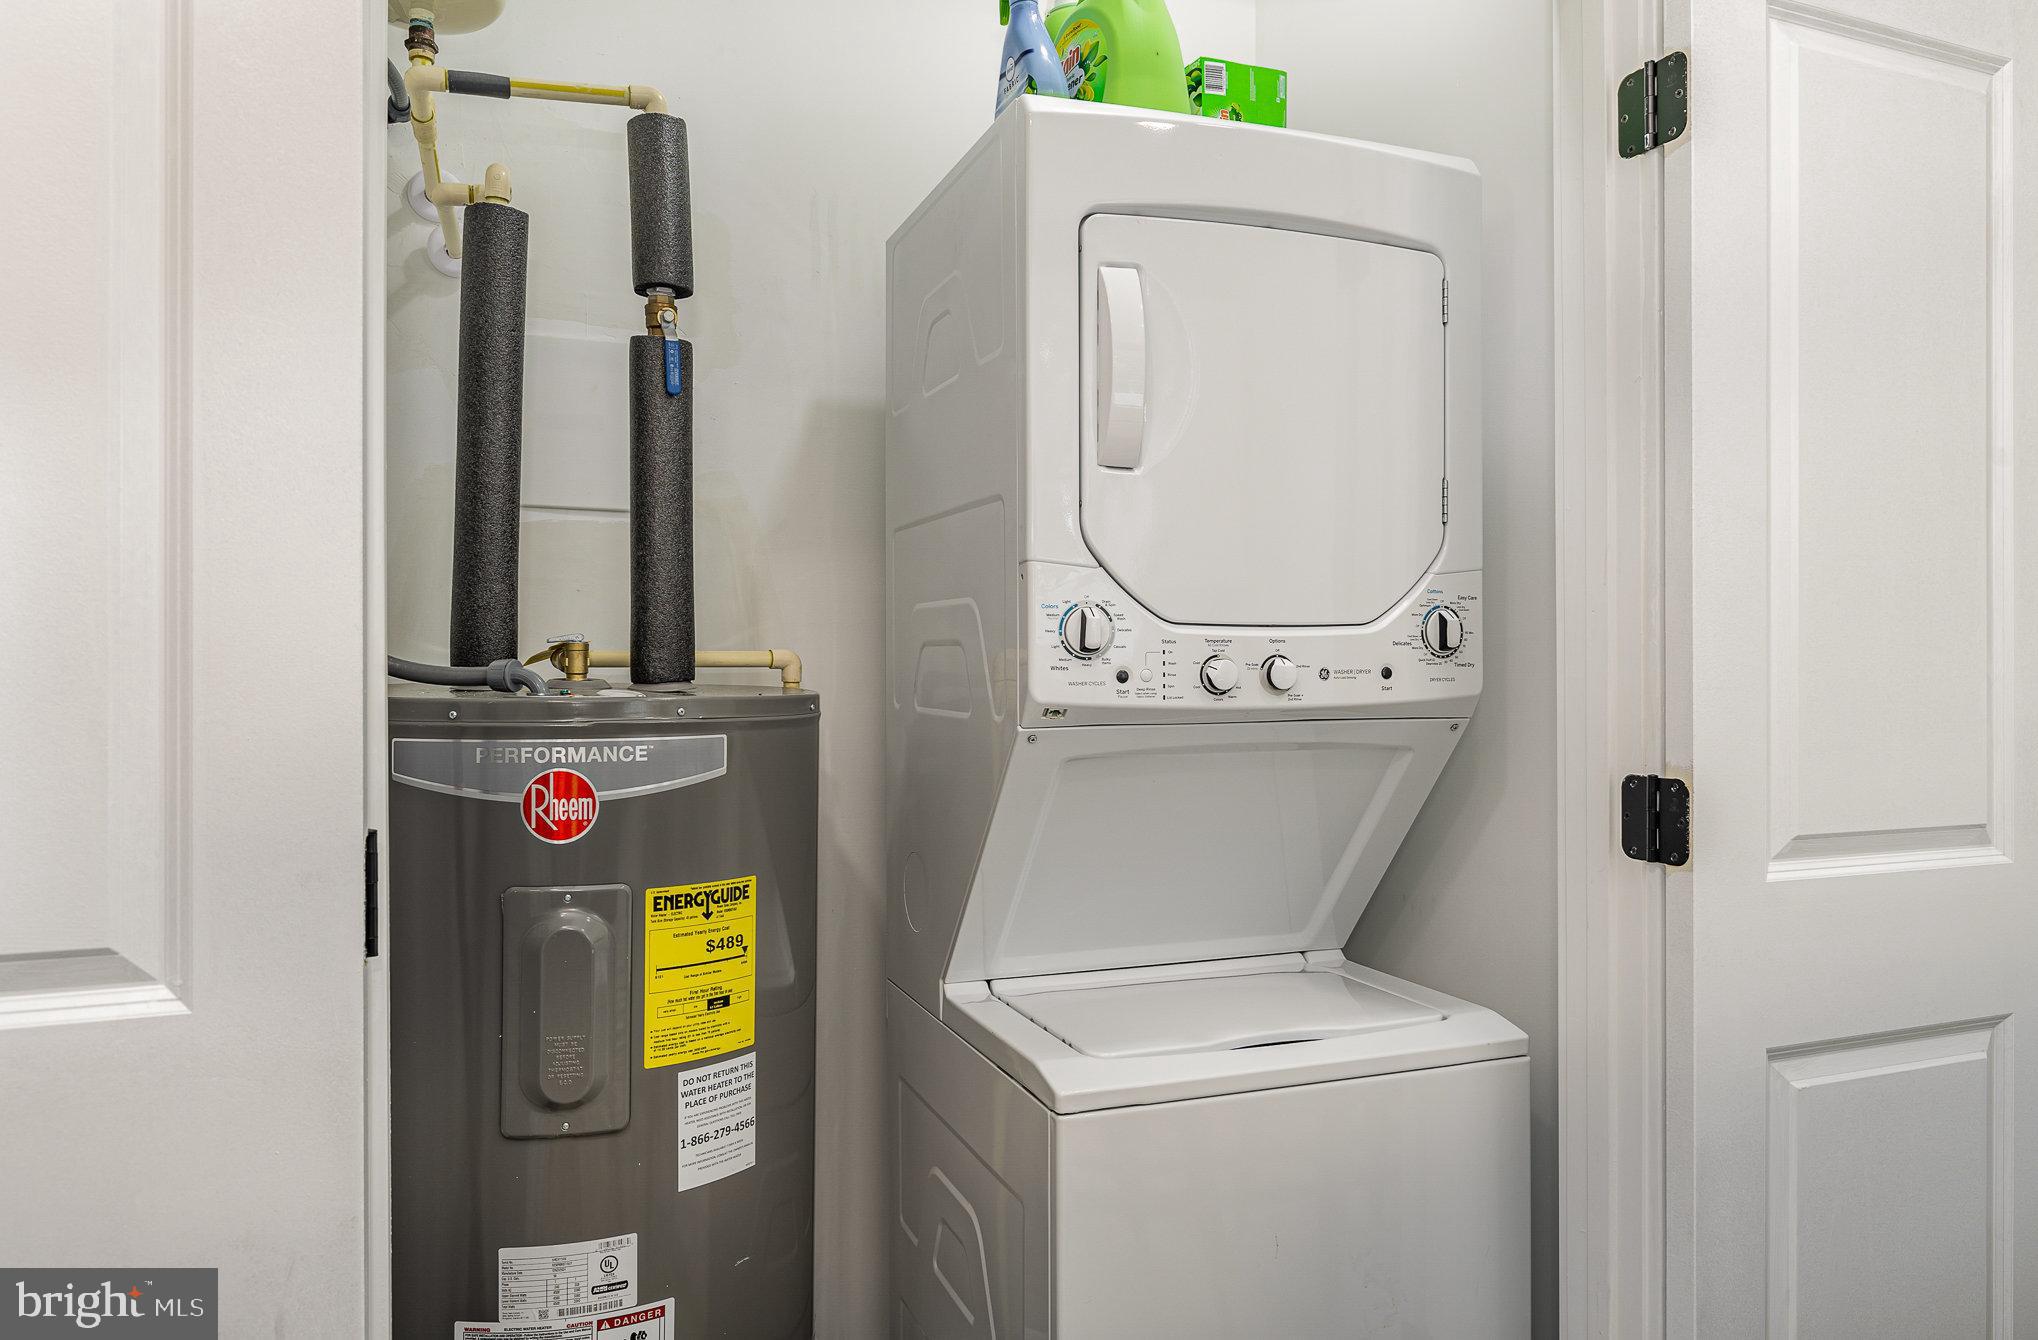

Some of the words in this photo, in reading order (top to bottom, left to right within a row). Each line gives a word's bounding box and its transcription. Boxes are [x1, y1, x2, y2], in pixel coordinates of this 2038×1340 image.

[476, 744, 648, 764] PERFORMANCE
[531, 771, 593, 831] Rheem
[653, 884, 750, 914] ENERGYGUIDE
[705, 934, 744, 953] $489
[680, 1086, 707, 1098] WATER
[707, 1079, 733, 1092] HEATER
[733, 1075, 743, 1084] TO
[743, 1070, 755, 1079] THE
[682, 1078, 695, 1087] DO
[696, 1073, 712, 1084] NOT
[712, 1065, 739, 1080] RETURN
[740, 1060, 754, 1070] THIS
[684, 1097, 707, 1109] PLACE
[708, 1094, 718, 1102] OF
[719, 1082, 752, 1100] PURCHASE
[680, 1116, 755, 1150] 1-866-279-4566
[604, 1259, 615, 1270] UL
[566, 1320, 593, 1329] CAUTION
[613, 1308, 662, 1327] DANGER
